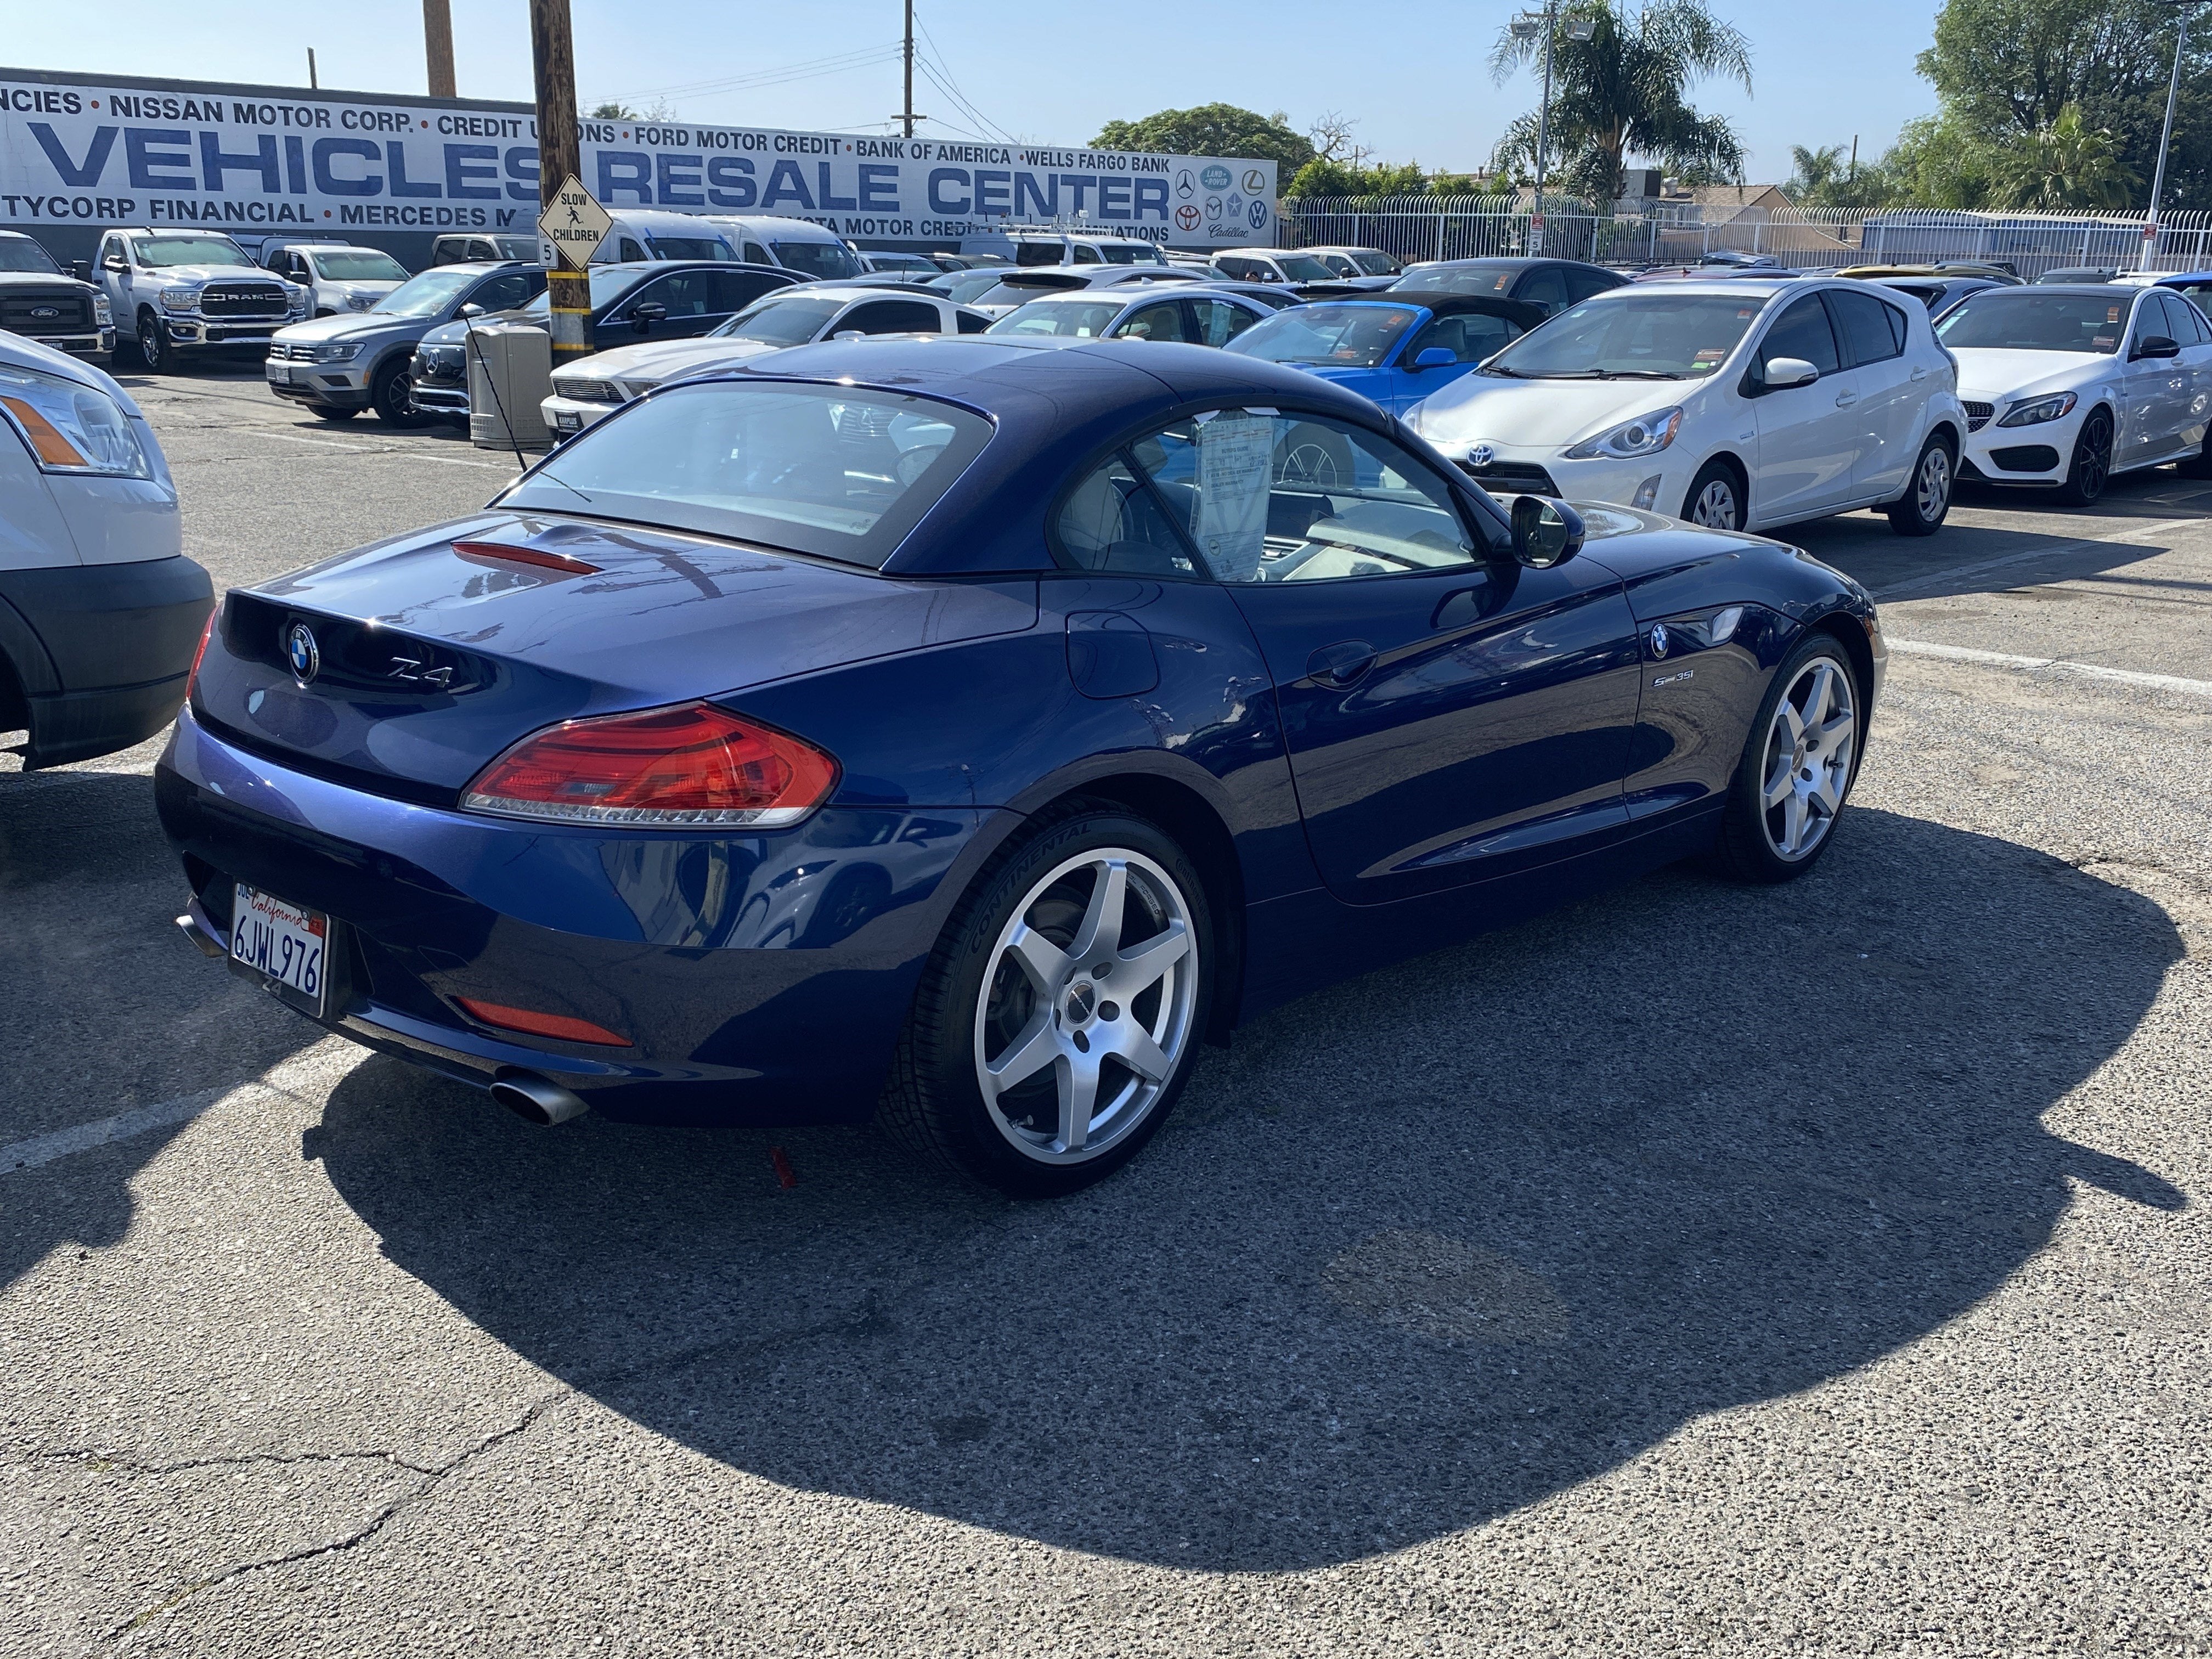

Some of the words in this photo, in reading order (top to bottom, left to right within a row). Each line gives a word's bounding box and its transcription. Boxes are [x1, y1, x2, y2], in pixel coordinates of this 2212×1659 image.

[110, 95, 223, 122] NISSAN
[233, 103, 331, 128] MOTOR
[341, 109, 414, 133] CORP.
[437, 115, 522, 138] CREDIT
[635, 126, 689, 146] FORD
[696, 130, 768, 151] MOTOR
[774, 135, 841, 155] CREDIT
[856, 139, 905, 159] BANK
[911, 143, 932, 160] OF
[936, 145, 1012, 165] AMERICA
[26, 121, 540, 201] VEHICLES
[596, 149, 900, 212] RESALE
[927, 167, 1170, 221] CENTER
[1025, 150, 1074, 168] WELLS
[1079, 153, 1126, 171] FARGO
[1131, 156, 1170, 173] BANK
[1, 195, 136, 219] TYCORP
[150, 199, 314, 223] FINANCIAL
[561, 193, 586, 206] SLOW
[340, 204, 487, 227] MERCEDES
[845, 217, 913, 235] MOTOR
[553, 228, 599, 242] CHILDREN
[1208, 223, 1249, 238] Cadillac
[544, 244, 552, 261] 5
[387, 656, 453, 689] Z4
[971, 822, 1092, 954] CONTINENTAL
[1139, 884, 1160, 915] FORGED
[251, 891, 303, 927] California
[235, 915, 320, 994] 6JWL976
[262, 974, 283, 996] Z4
